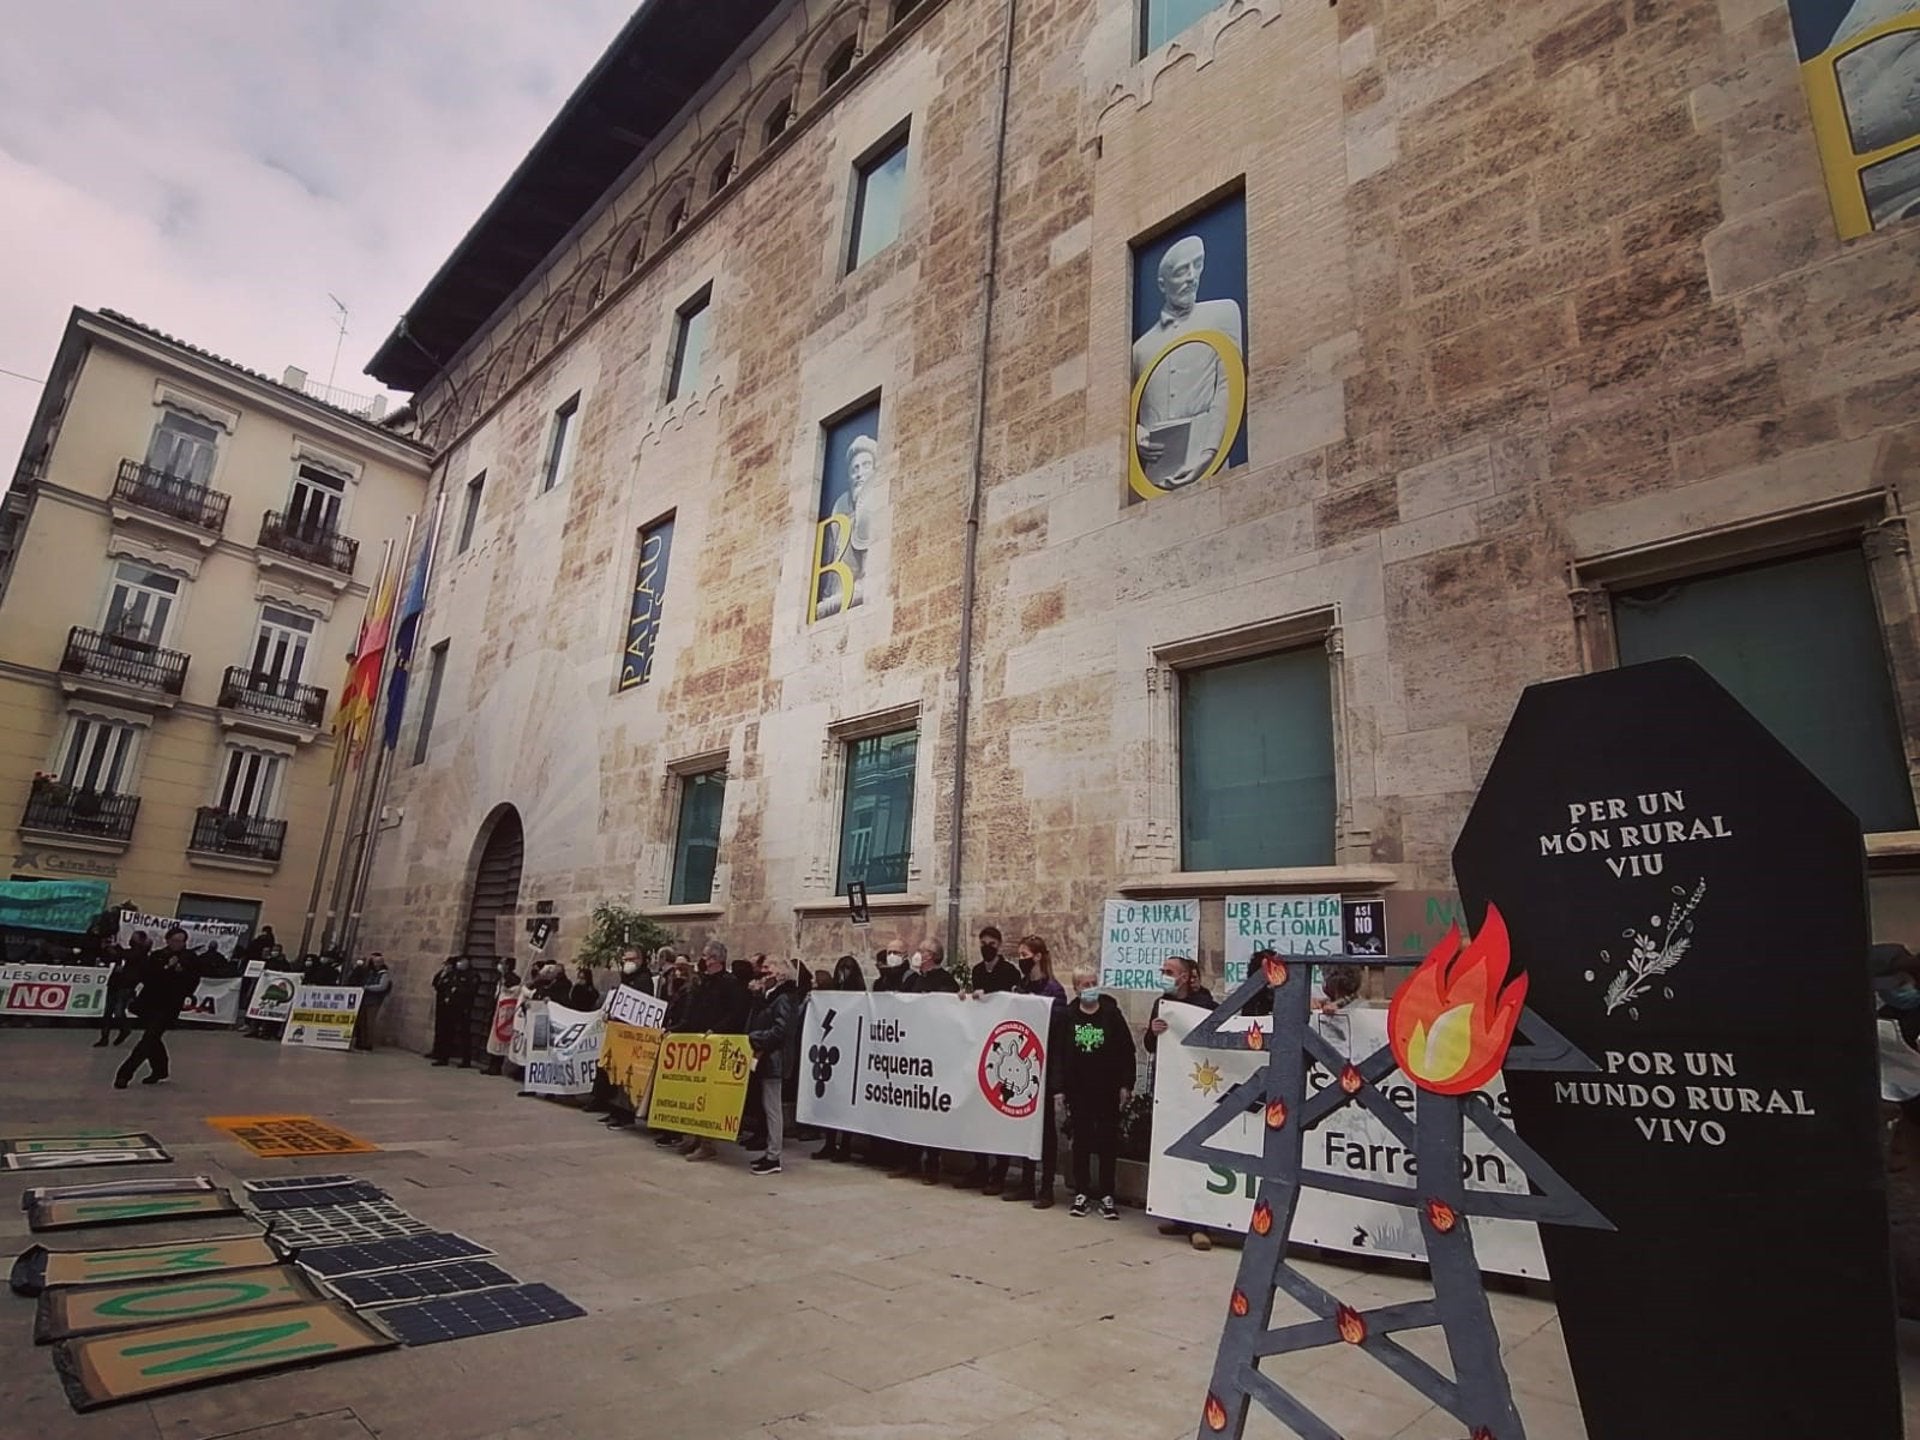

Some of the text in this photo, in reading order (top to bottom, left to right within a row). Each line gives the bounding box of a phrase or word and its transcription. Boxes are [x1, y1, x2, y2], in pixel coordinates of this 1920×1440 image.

[622, 536, 662, 687] PALAU
[1568, 790, 1686, 825] PER UN
[1539, 815, 1732, 856] MÓN RURAL
[1605, 853, 1664, 879] VIU
[1117, 904, 1193, 924] LO RURAL
[1227, 897, 1341, 919] UBICACIÓN
[1355, 903, 1372, 917] ASÍ
[1110, 926, 1191, 945] NO SE VENDE
[1239, 918, 1341, 937] RACIONAL
[1354, 916, 1373, 934] NO
[1116, 946, 1134, 964] SE
[1290, 938, 1333, 957] LAS
[2, 970, 33, 982] LES
[38, 971, 91, 984] COVES
[12, 986, 104, 1010] NO al
[615, 991, 664, 1030] PETRER
[869, 1019, 906, 1043] utiel-
[664, 1041, 711, 1071] STOP
[867, 1051, 934, 1081] requena
[1605, 1050, 1738, 1077] POR UN
[864, 1081, 953, 1114] sostenible
[1554, 1081, 1816, 1116] MUNDO RURAL
[724, 1115, 739, 1132] NO
[1635, 1116, 1727, 1147] VIVO
